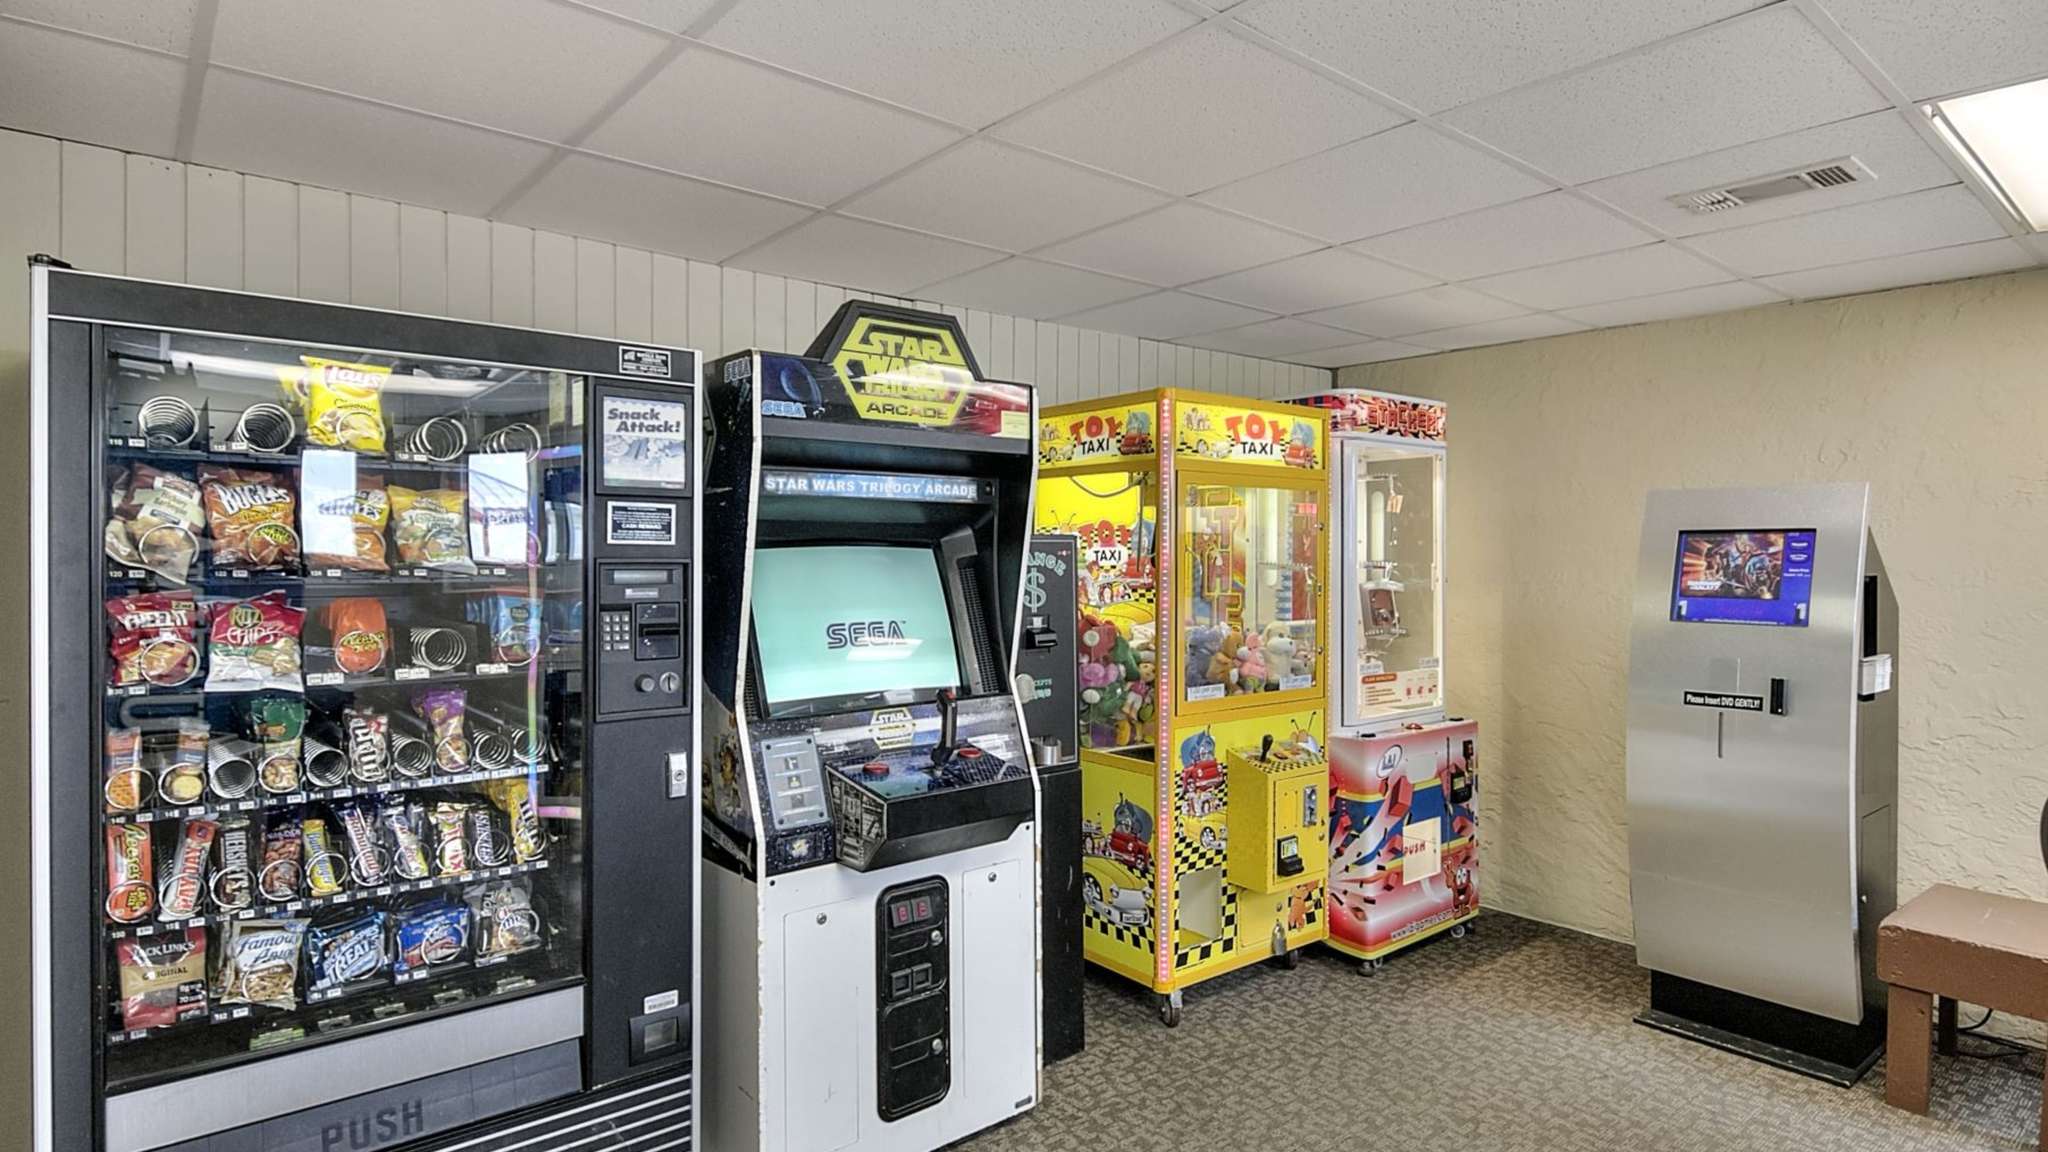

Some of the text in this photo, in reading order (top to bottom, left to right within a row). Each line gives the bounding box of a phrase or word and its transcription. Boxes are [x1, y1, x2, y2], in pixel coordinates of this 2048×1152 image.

[859, 331, 951, 361] STAR
[607, 407, 660, 420] Snack
[761, 400, 806, 418] SEGA
[866, 402, 948, 420] ARCADE
[616, 420, 680, 433] Attack!
[1069, 415, 1123, 444] TOY
[1225, 413, 1287, 444] TOY
[1081, 438, 1110, 455] TAXI
[1241, 441, 1274, 455] TAXI
[765, 475, 978, 498] STAR WARS TRILOGY ARCADE
[212, 483, 291, 515] BUGLES
[1027, 552, 1067, 576] ANGE
[1094, 550, 1121, 564] TAXI
[231, 608, 260, 628] RITZ
[226, 625, 279, 645] CHIPS
[827, 620, 906, 649] SEGA
[1686, 693, 1760, 708] Please Insert DVD GENTLY!
[122, 824, 147, 881] Reese's
[1404, 841, 1426, 856] PUSH
[224, 831, 249, 888] HERSHEY'S
[162, 941, 196, 954] LINK'S
[329, 934, 379, 984] TREATS
[142, 967, 188, 980] OIGINAL
[321, 1096, 424, 1152] PUSH
